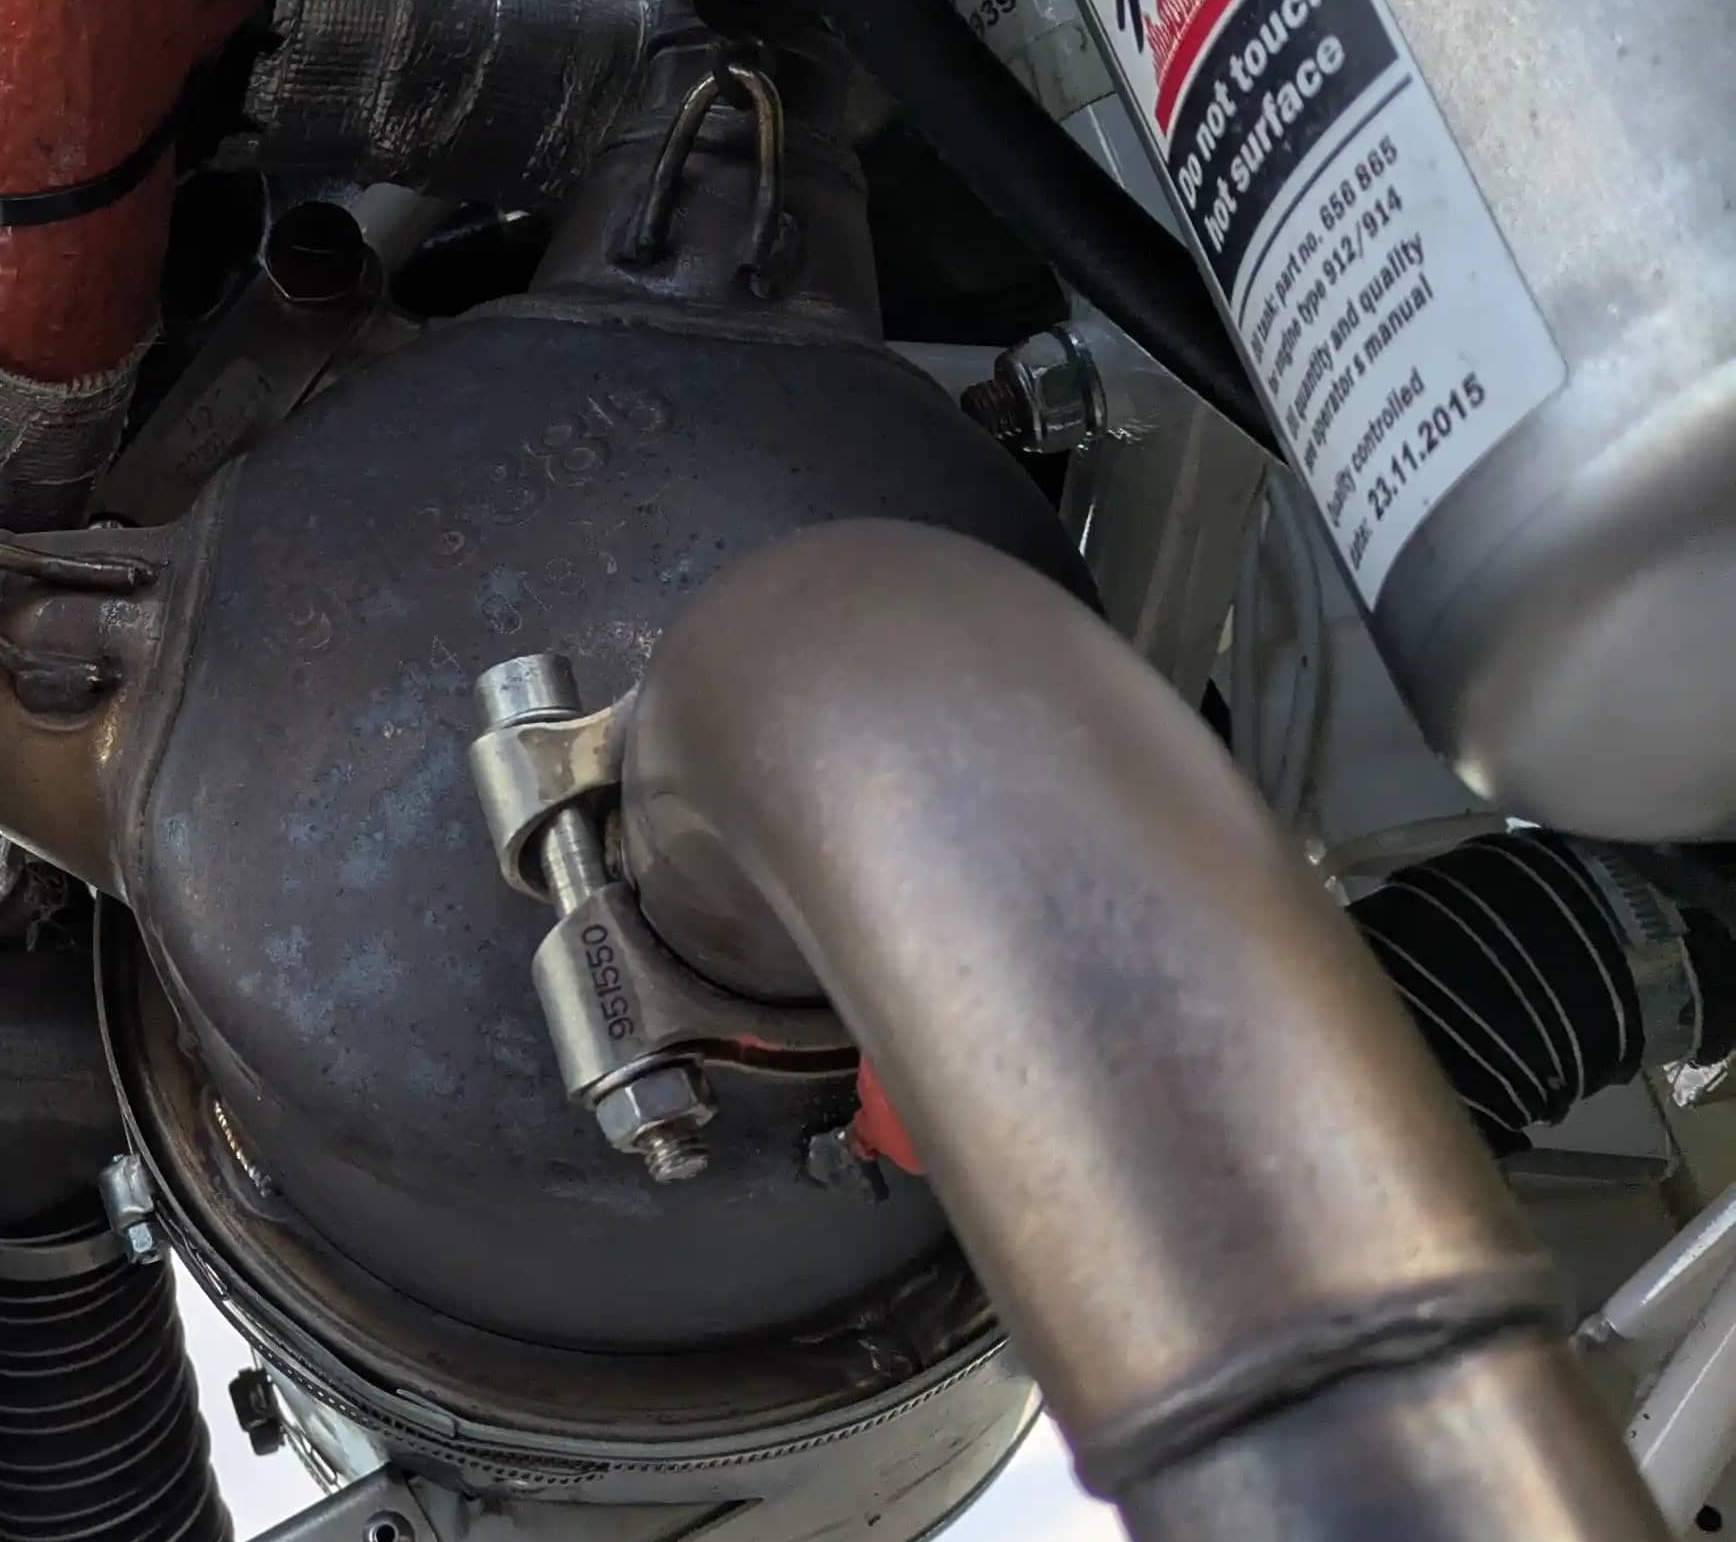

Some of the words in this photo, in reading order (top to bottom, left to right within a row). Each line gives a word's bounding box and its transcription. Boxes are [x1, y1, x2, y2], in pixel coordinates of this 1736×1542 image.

[1177, 152, 1204, 210] Do
[1196, 79, 1238, 162] not
[1204, 176, 1238, 255] hot
[1230, 34, 1346, 194] surface
[1296, 278, 1328, 326] type
[1322, 184, 1404, 286] 912/914
[1330, 297, 1361, 352] and
[1358, 230, 1427, 312] quality
[1363, 271, 1436, 366] manual
[1351, 364, 1426, 475] controlled
[1367, 370, 1486, 523] 23.11.2015
[582, 923, 635, 1041] 951550
